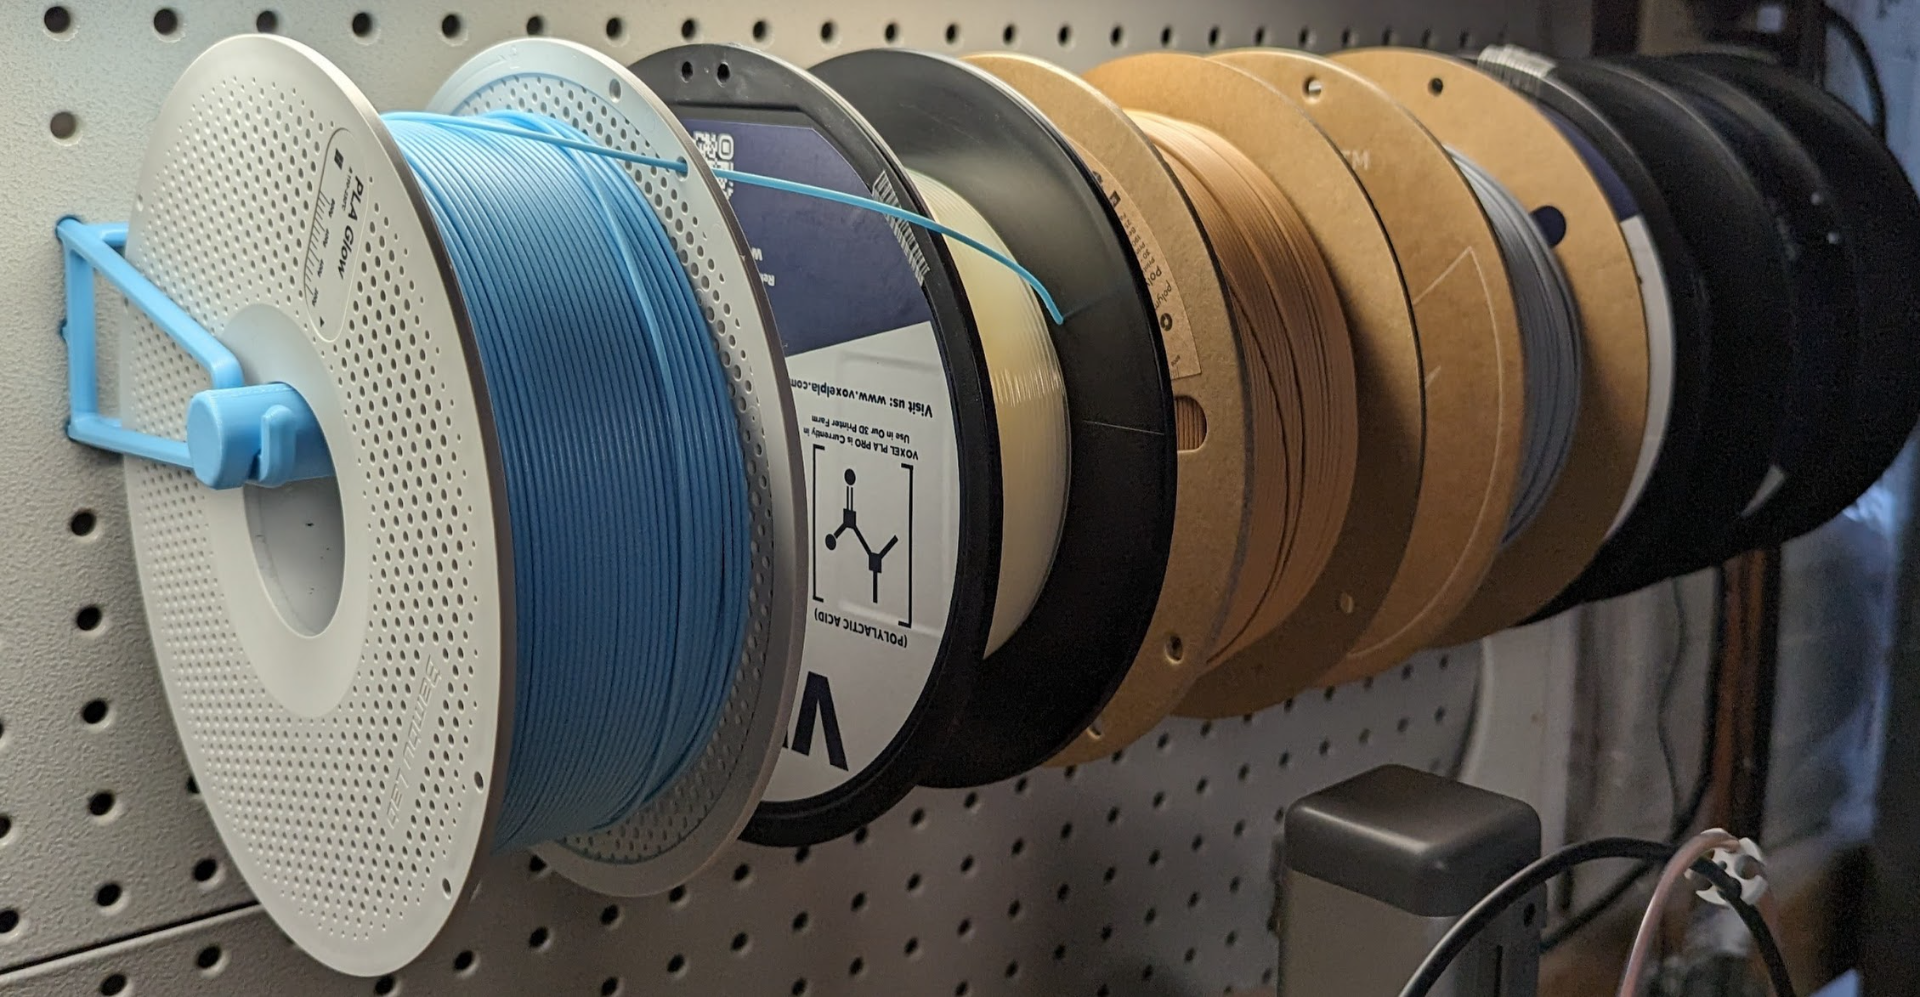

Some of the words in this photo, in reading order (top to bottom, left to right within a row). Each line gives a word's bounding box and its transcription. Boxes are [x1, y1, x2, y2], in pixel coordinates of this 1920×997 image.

[348, 176, 364, 221] PLA
[339, 225, 354, 280] Glow
[889, 397, 905, 409] us:
[907, 401, 933, 418] Visit
[811, 415, 830, 427] Farm
[831, 419, 857, 433] Printer
[803, 427, 810, 437] in
[811, 428, 845, 445] Currently
[859, 425, 869, 435] 3D
[870, 427, 885, 439] Our
[886, 431, 893, 441] in
[847, 437, 853, 447] is
[854, 438, 872, 452] PRO
[895, 433, 910, 444] Use
[873, 443, 888, 455] PLA
[890, 445, 918, 461] VOXEL
[814, 608, 841, 628] ACID)
[843, 618, 908, 648] (POLYLACTIC
[782, 671, 849, 772] V
